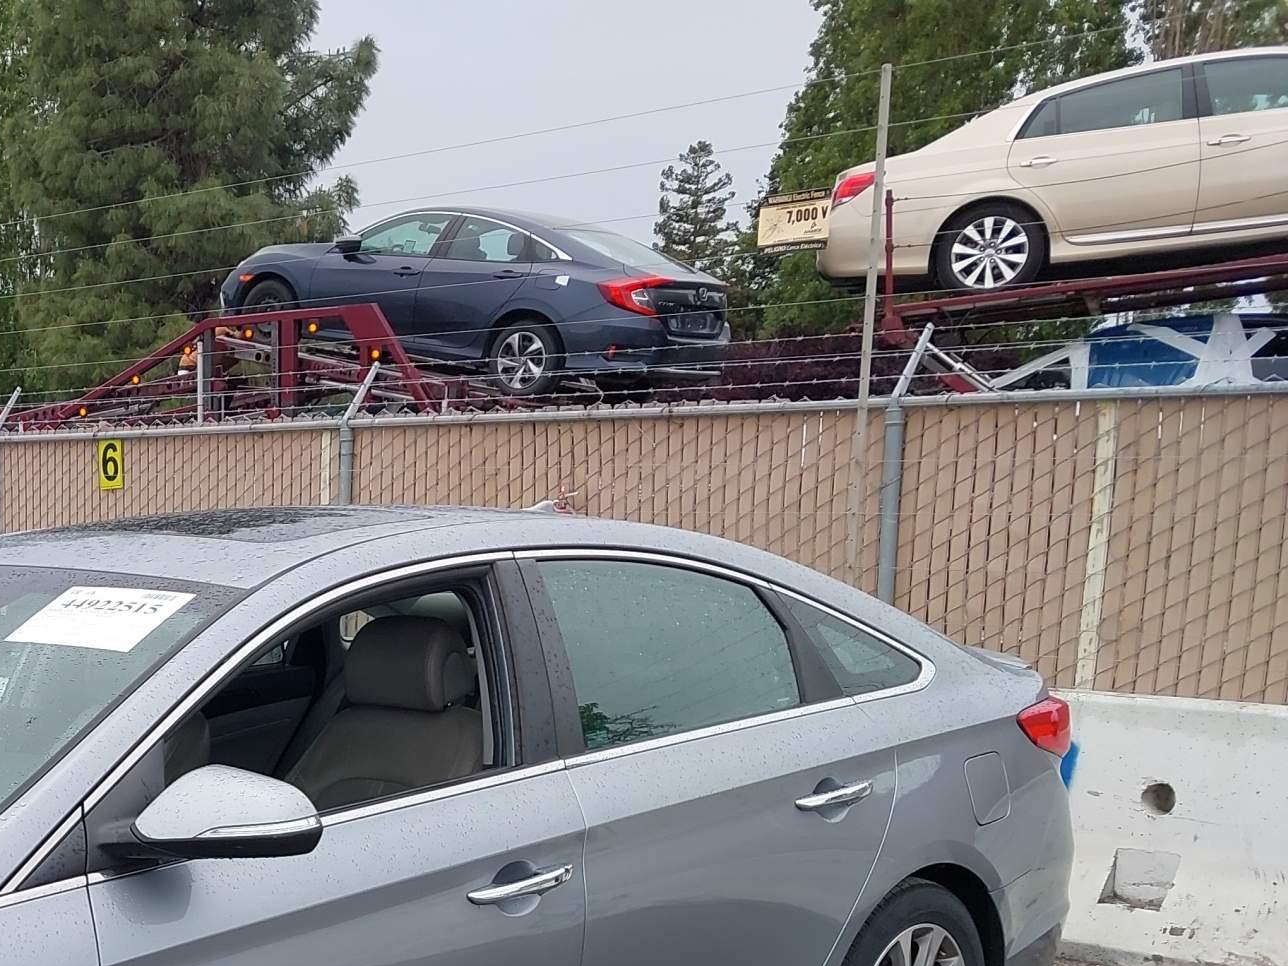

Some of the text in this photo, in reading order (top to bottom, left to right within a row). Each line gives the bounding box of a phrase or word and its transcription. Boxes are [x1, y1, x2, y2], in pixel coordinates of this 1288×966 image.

[786, 206, 818, 225] 7,000
[821, 205, 829, 219] V
[101, 442, 119, 482] 6
[62, 598, 164, 615] 44922515
